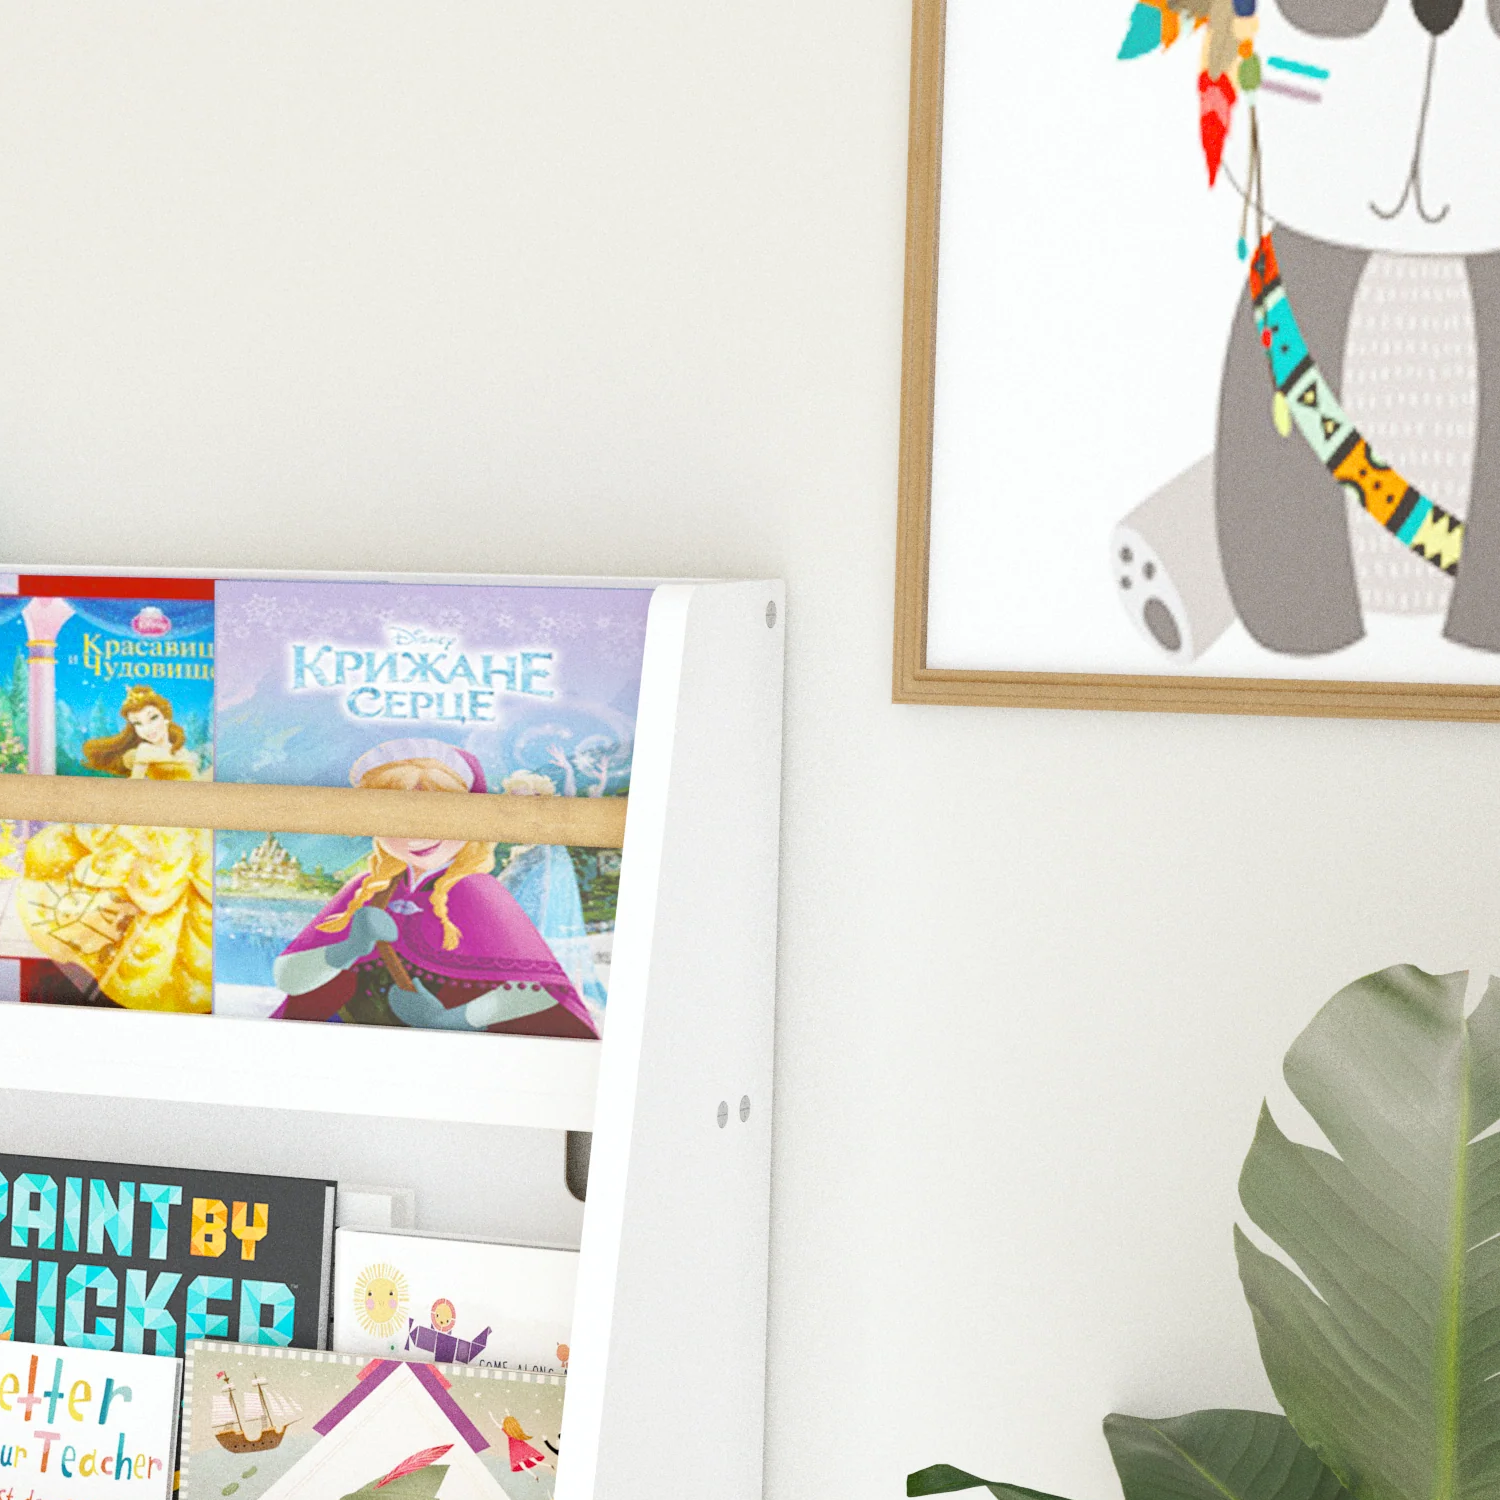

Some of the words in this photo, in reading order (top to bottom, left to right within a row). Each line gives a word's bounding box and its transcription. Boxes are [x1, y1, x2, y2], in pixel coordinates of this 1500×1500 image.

[292, 644, 555, 698] КРИЖАНЕ
[347, 686, 496, 724] СЕРЦЕ
[189, 1197, 269, 1261] BY
[33, 1430, 163, 1480] Teacher
